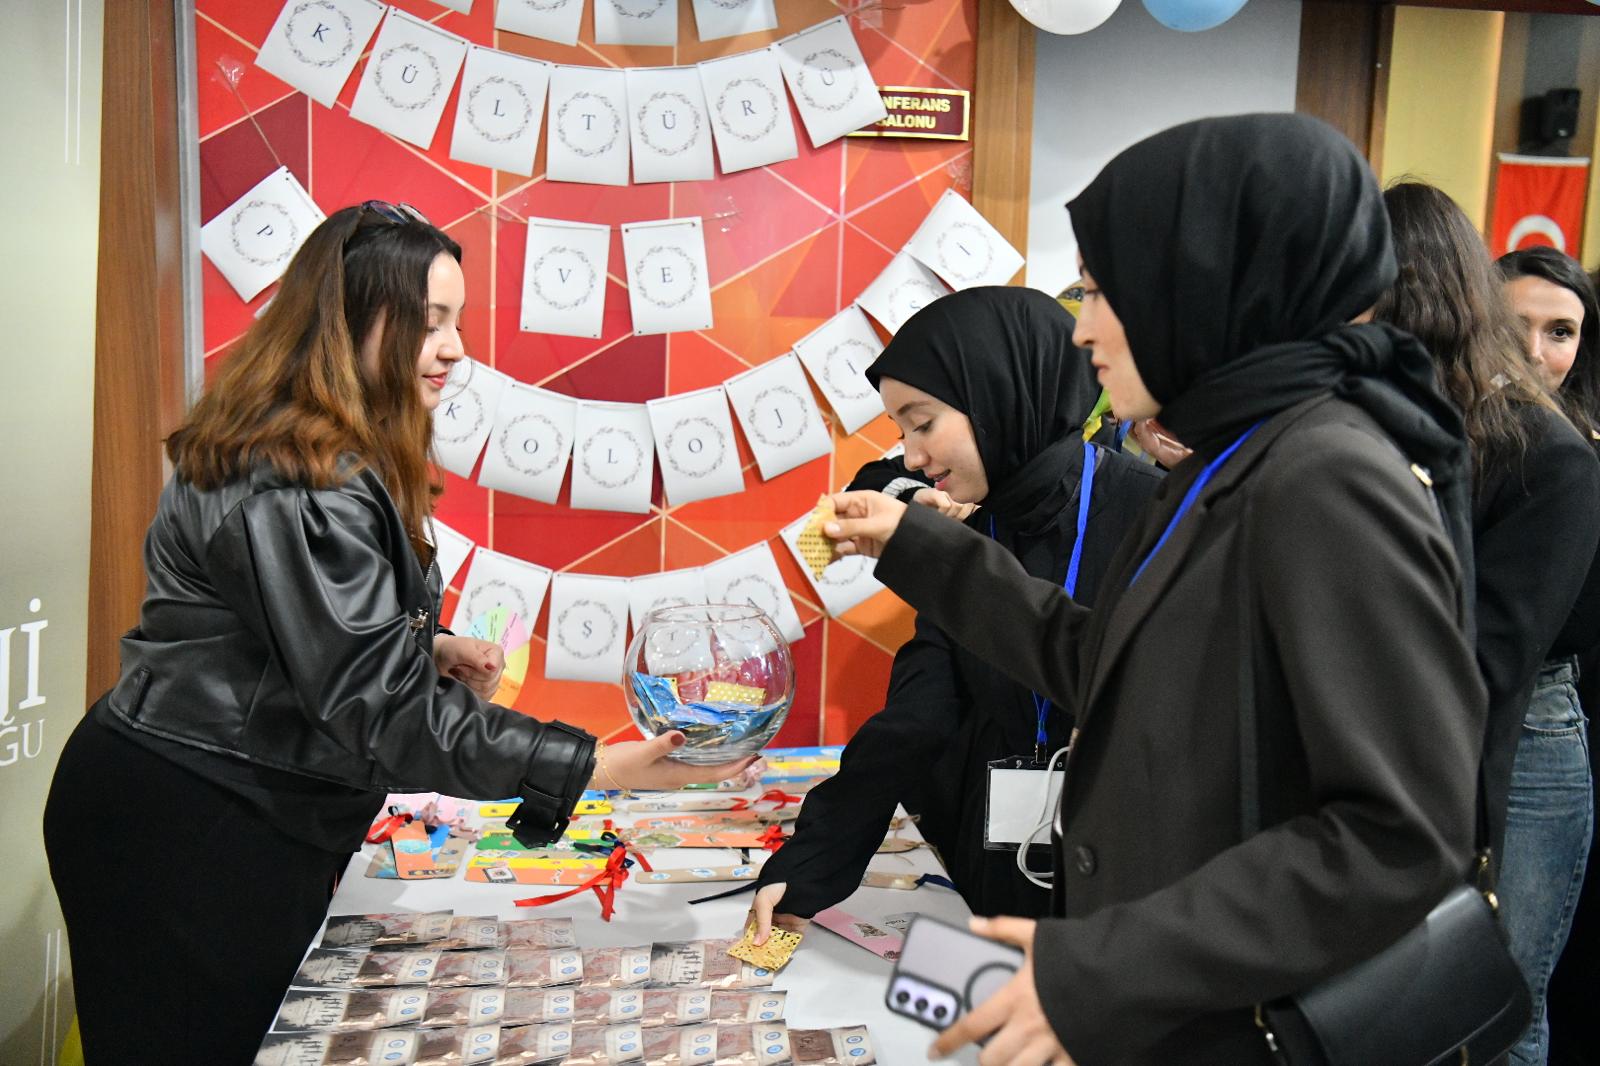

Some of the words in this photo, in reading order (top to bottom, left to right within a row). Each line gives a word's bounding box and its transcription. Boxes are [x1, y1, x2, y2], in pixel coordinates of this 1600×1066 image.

[311, 22, 331, 43] K
[401, 63, 419, 84] Ü
[493, 98, 505, 118] L
[581, 113, 596, 131] T
[661, 110, 676, 130] Ü
[741, 99, 756, 117] R
[558, 267, 572, 284] V
[660, 266, 673, 284] E
[523, 439, 539, 454] O
[607, 448, 618, 464] L
[687, 438, 703, 453] O
